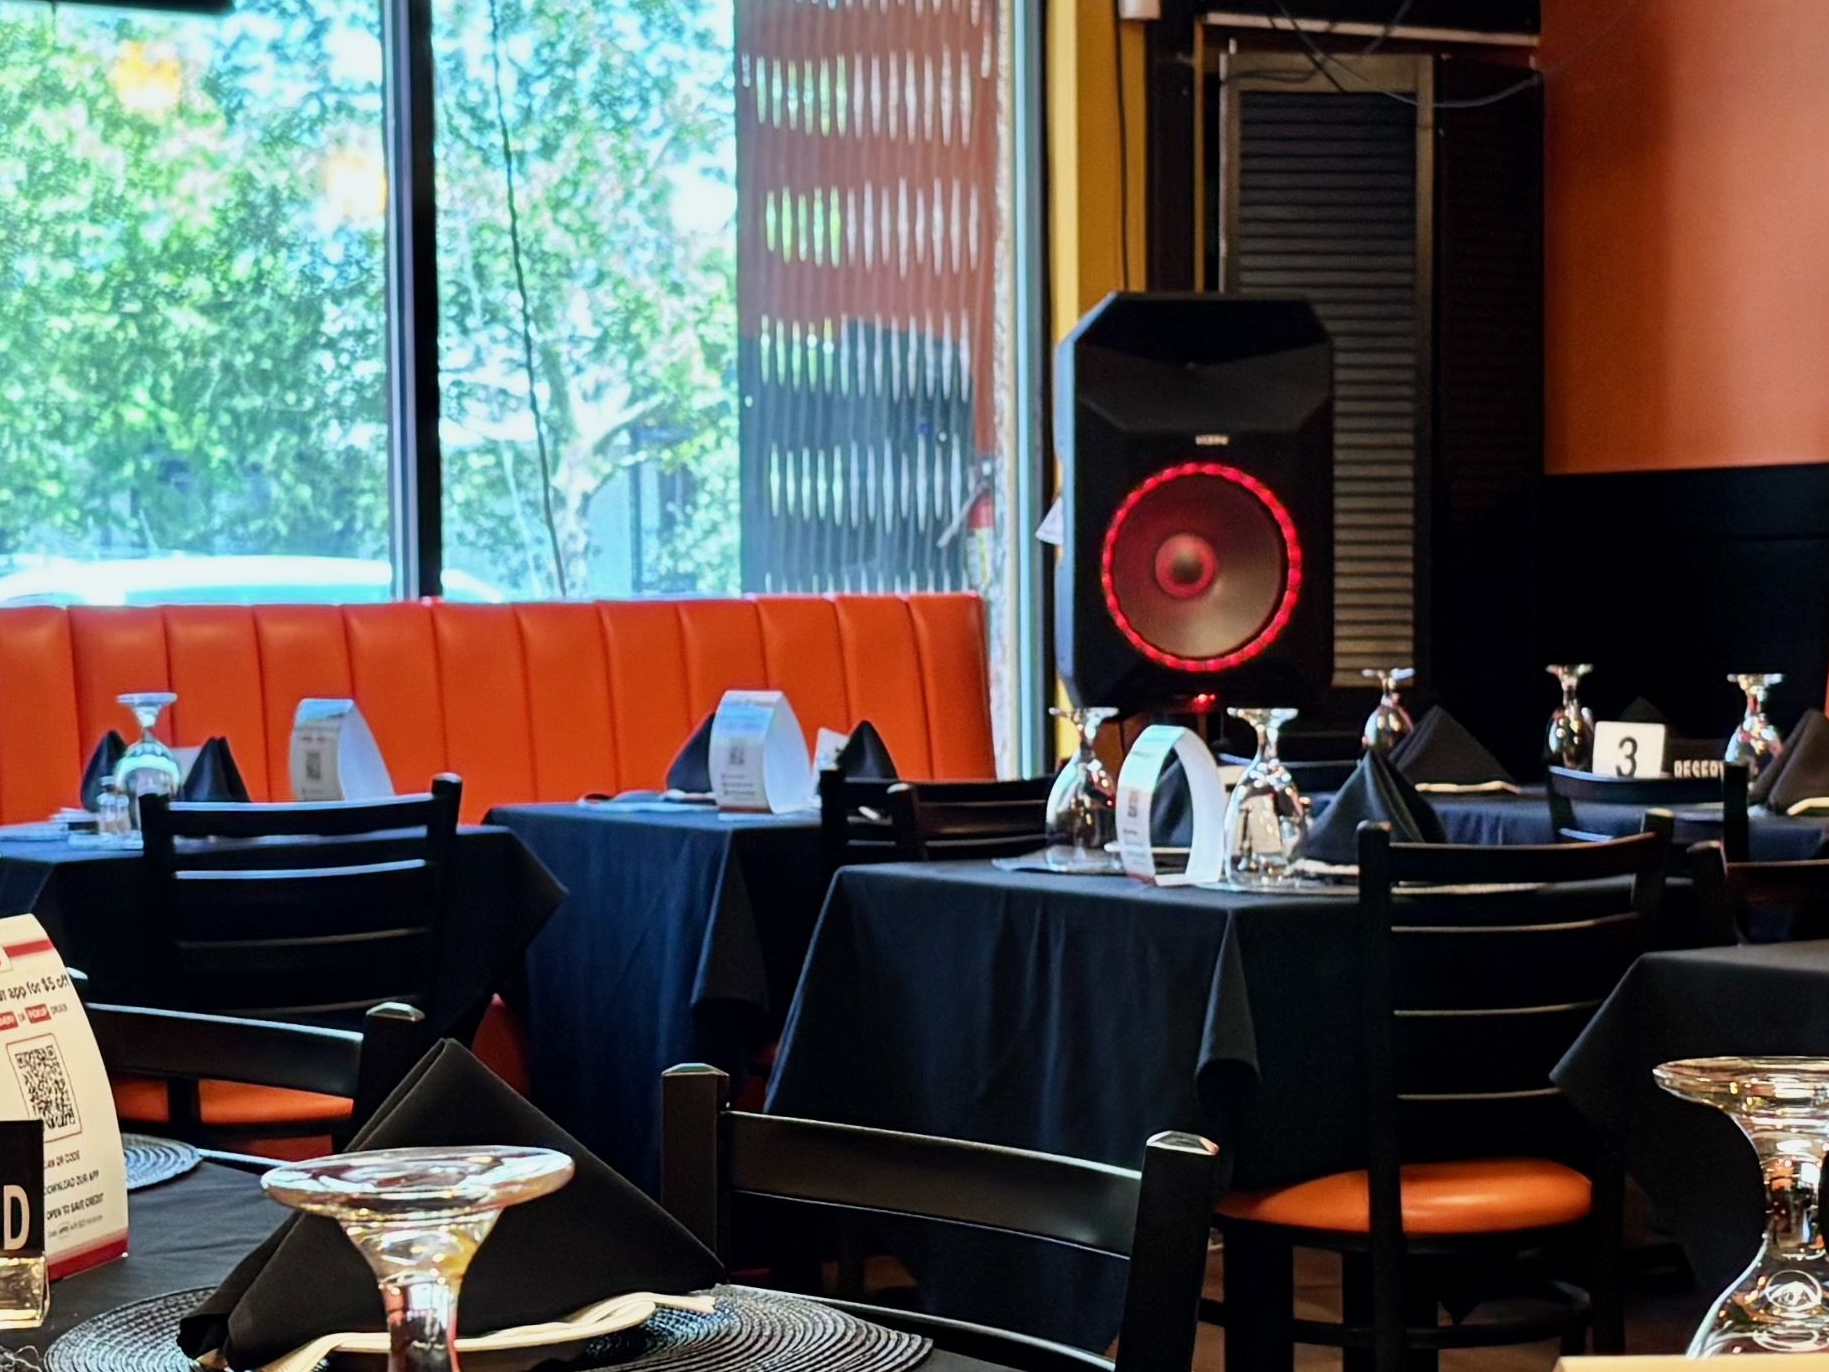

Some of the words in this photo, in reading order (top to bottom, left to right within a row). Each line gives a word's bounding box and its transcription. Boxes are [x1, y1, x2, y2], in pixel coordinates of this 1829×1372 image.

[1615, 736, 1637, 777] 3
[1673, 759, 1724, 778] RESER
[8, 984, 26, 999] app
[27, 980, 40, 994] for
[41, 975, 56, 991] $5
